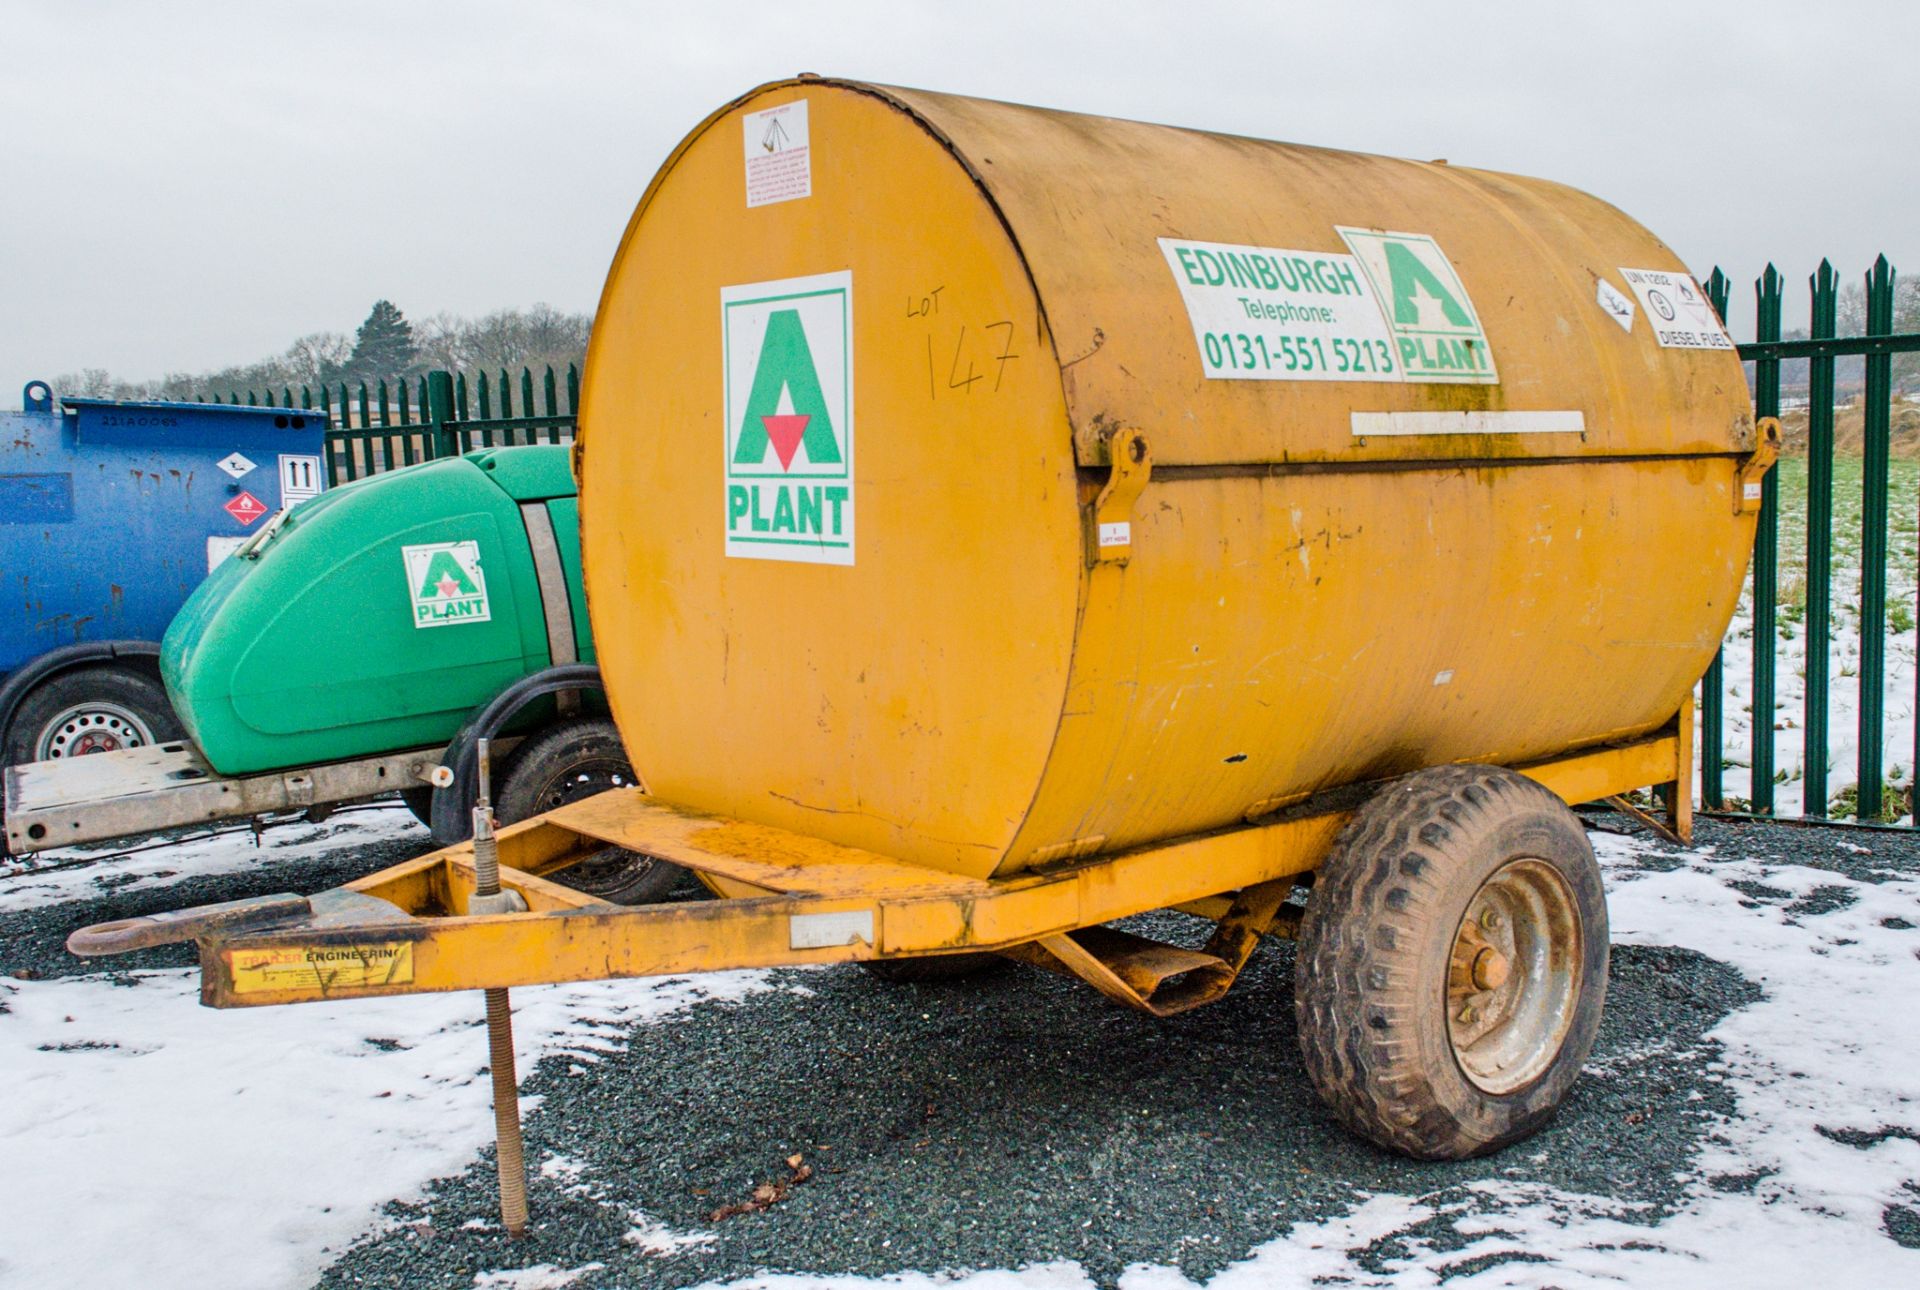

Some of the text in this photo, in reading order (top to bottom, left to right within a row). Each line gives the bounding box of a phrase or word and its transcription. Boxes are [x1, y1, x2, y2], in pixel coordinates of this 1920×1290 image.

[1174, 247, 1363, 297] EDINBURGH
[1625, 271, 1645, 285] UN
[906, 286, 946, 318] LOT
[1237, 297, 1337, 325] Telephone:
[1204, 331, 1394, 373] 0131-551 5213
[1397, 337, 1488, 371] PLANT
[1659, 330, 1731, 347] DIESEL FUEL
[927, 320, 1019, 400] 147
[733, 309, 842, 464] A
[729, 485, 849, 536] PLANT
[419, 551, 480, 598] A
[417, 598, 484, 620] PLANT
